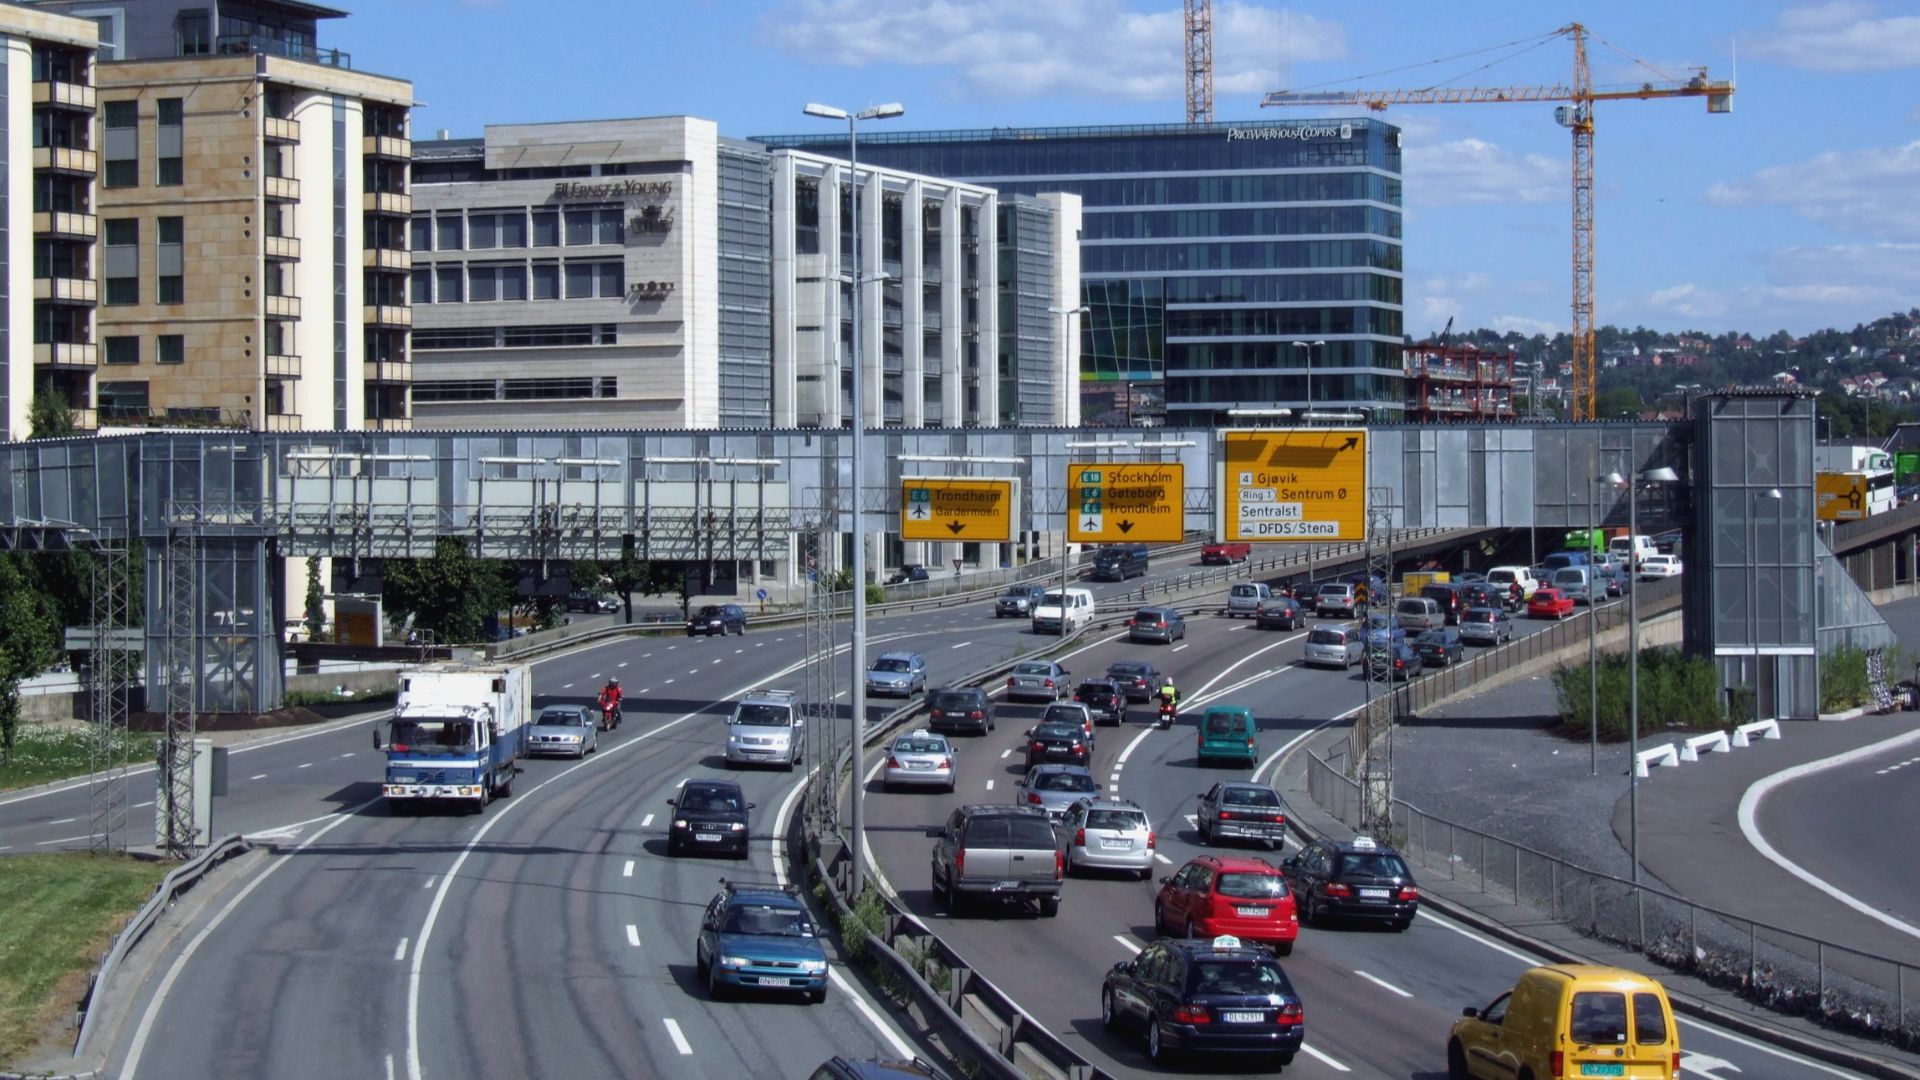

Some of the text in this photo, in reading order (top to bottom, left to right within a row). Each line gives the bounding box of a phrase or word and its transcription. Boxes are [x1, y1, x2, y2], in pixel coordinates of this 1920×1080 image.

[571, 180, 672, 198] ERNST & YOUNG
[1083, 472, 1172, 483] E 18 Stockholm
[1242, 473, 1298, 487] 4 Gjøvik
[912, 490, 1001, 501] E 6 Trondheim
[1092, 489, 1098, 497] 6
[1108, 487, 1165, 501] Gøteborg
[1243, 491, 1264, 500] Ring
[1281, 488, 1334, 499] Sentrum
[935, 506, 1000, 517] Gardermoen
[1109, 503, 1171, 514] Trondheim
[1259, 523, 1334, 534] DFDS/Stena
